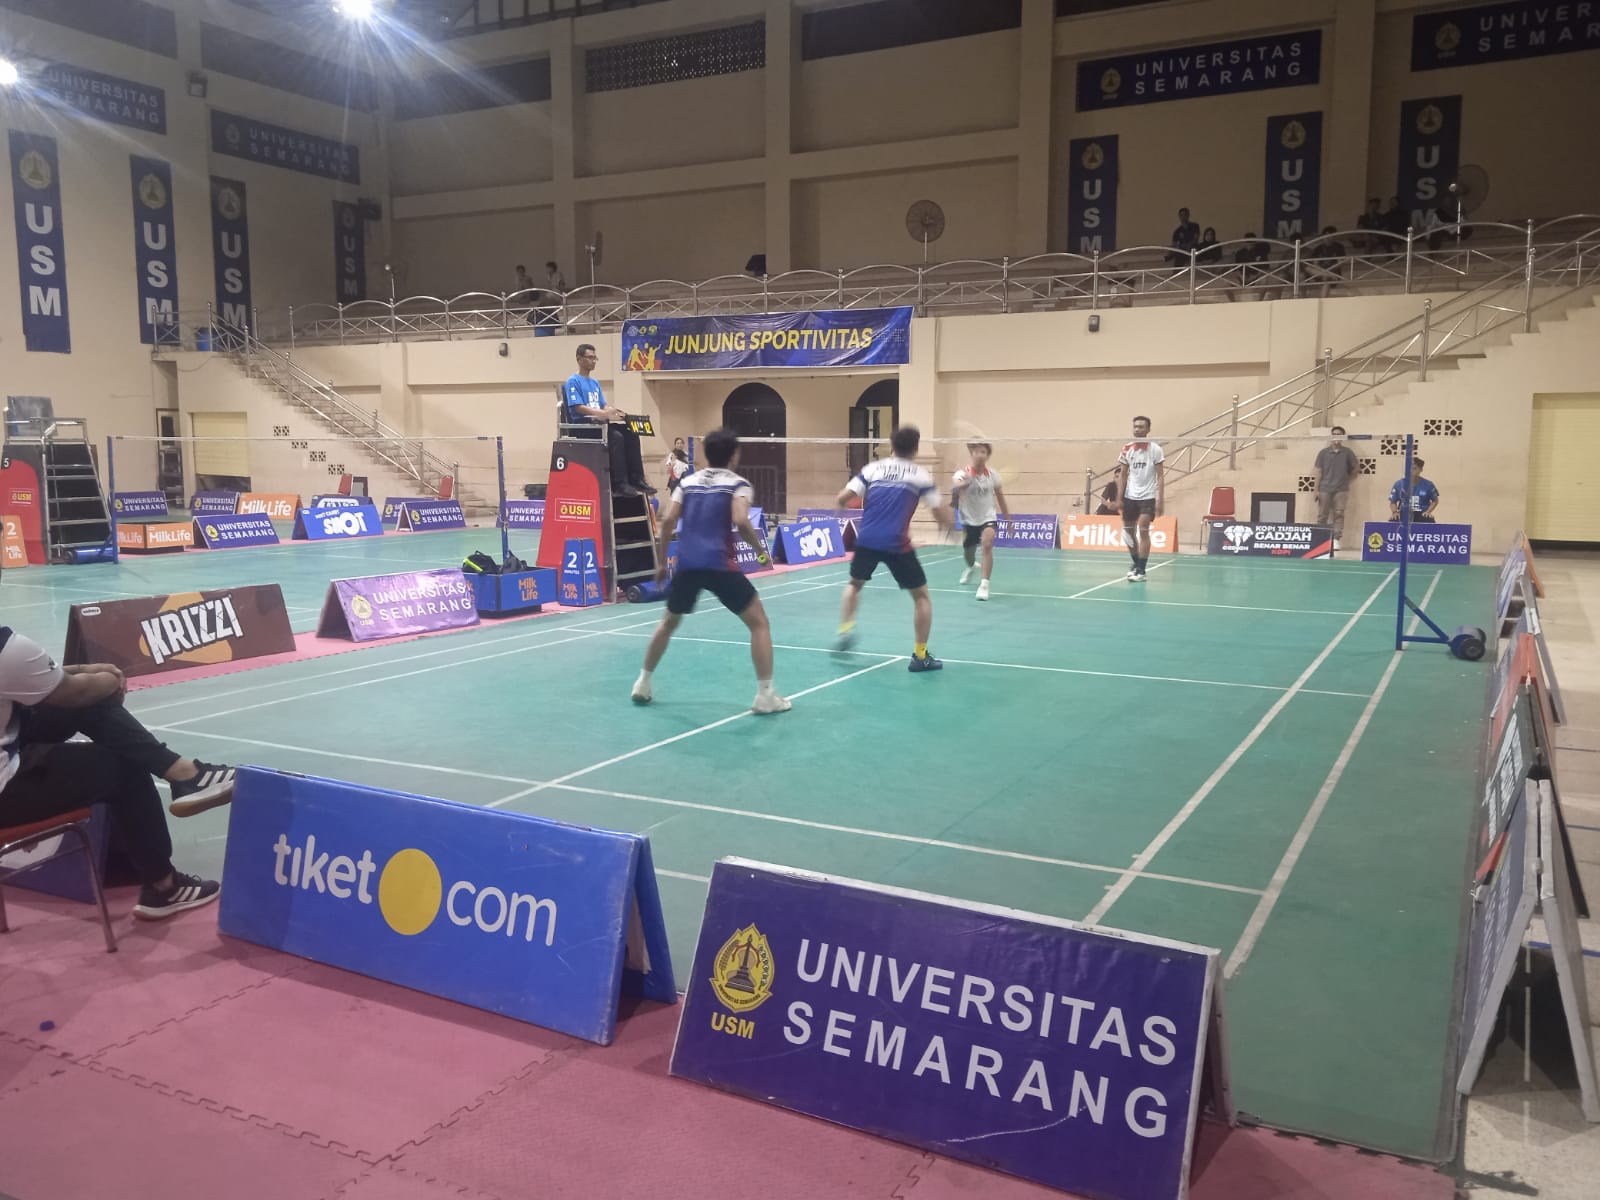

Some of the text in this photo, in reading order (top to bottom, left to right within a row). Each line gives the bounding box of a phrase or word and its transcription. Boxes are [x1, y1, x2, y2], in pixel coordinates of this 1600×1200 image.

[1135, 42, 1302, 77] UNIVERSITAS
[1135, 62, 1301, 96] SEMARANG
[49, 69, 159, 107] UNIVERSITAS
[1080, 179, 1102, 254] USM
[24, 202, 62, 318] USM
[342, 235, 358, 297] USM
[143, 221, 174, 326] USM
[220, 232, 248, 327] USM
[664, 328, 874, 355] JUNJUNG SPORTIVITAS
[3, 458, 9, 468] 5
[556, 457, 565, 470] 6
[17, 493, 32, 501] USM
[123, 497, 165, 505] UNIVERSITAS
[202, 497, 235, 505] UNIVERSITAS
[125, 503, 166, 511] SEMARANG
[240, 500, 292, 517] MilkLife
[420, 507, 461, 515] UNIVERSITAS
[569, 506, 591, 516] USM
[217, 520, 271, 531] UNIVERSITAS
[421, 515, 463, 523] SEMARANG
[6, 522, 17, 536] 2
[149, 529, 191, 543] MilkLife
[221, 529, 275, 540] SEMARANG
[1255, 532, 1312, 541] GADJAH
[1388, 532, 1468, 543] UNVERSITAS
[567, 551, 577, 568] 2
[585, 552, 594, 567] 2
[518, 577, 537, 590] Milk
[372, 582, 467, 604] UNIVERSITAS
[522, 589, 538, 601] Life
[379, 598, 473, 621] SEMARANG
[141, 596, 244, 664] KRIZZI
[796, 937, 1177, 1065] UNIVERSITAS
[711, 1012, 755, 1039] USM
[783, 1000, 1168, 1138] SEMARANG
